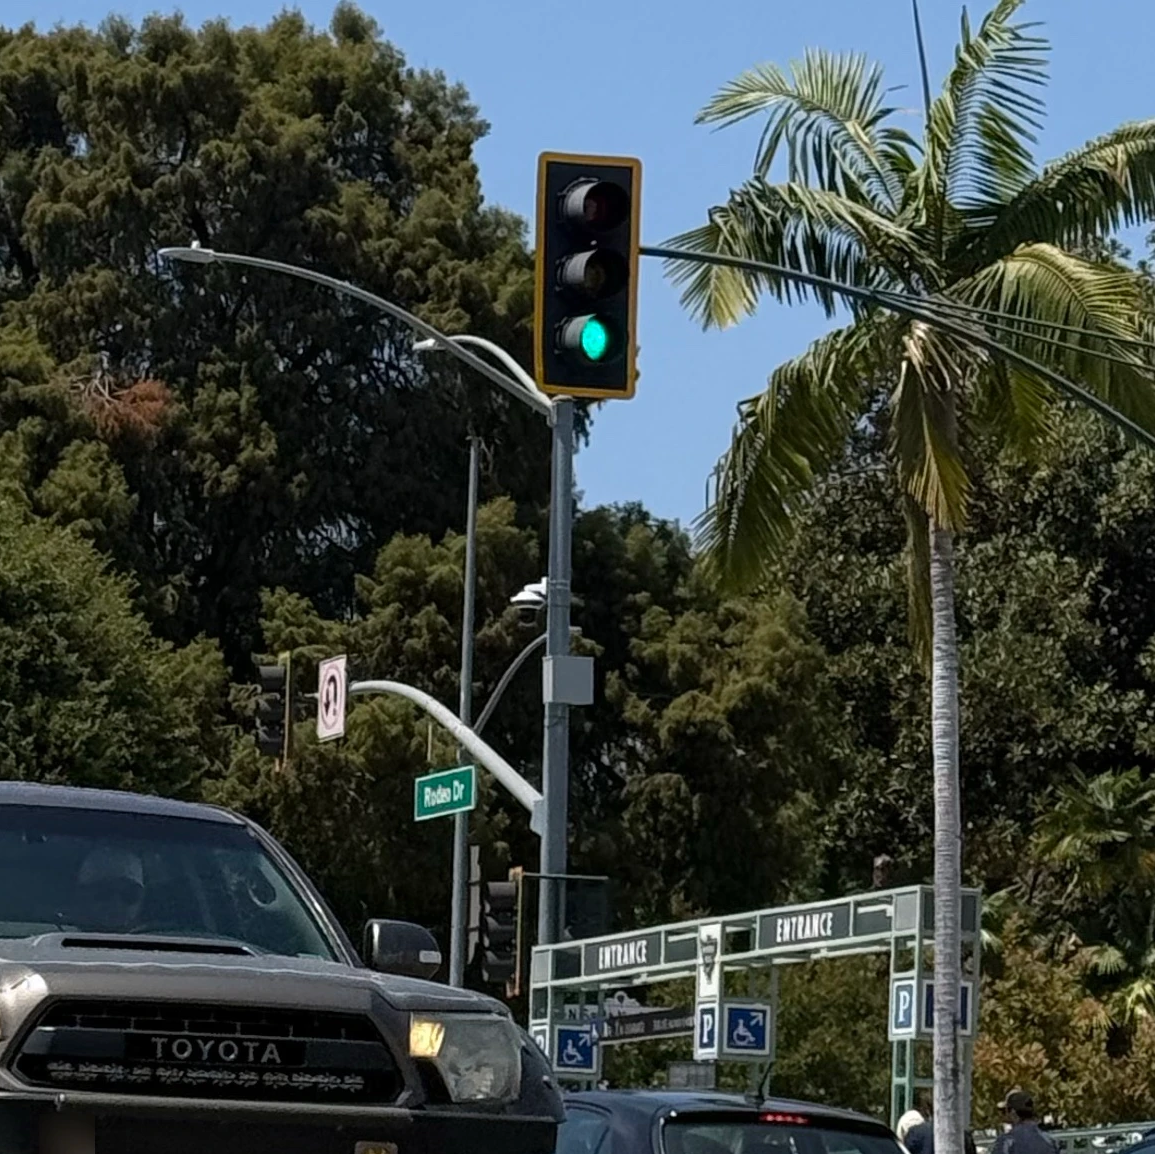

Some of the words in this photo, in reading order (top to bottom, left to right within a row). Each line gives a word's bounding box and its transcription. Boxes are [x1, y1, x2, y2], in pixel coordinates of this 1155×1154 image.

[424, 784, 451, 808] Rodeo
[452, 780, 465, 802] Dr
[776, 912, 833, 942] ENTRANCE
[598, 940, 647, 970] ENTRANCE
[898, 990, 909, 1024] P
[702, 1013, 713, 1044] P
[151, 1036, 282, 1064] TOYOTA
